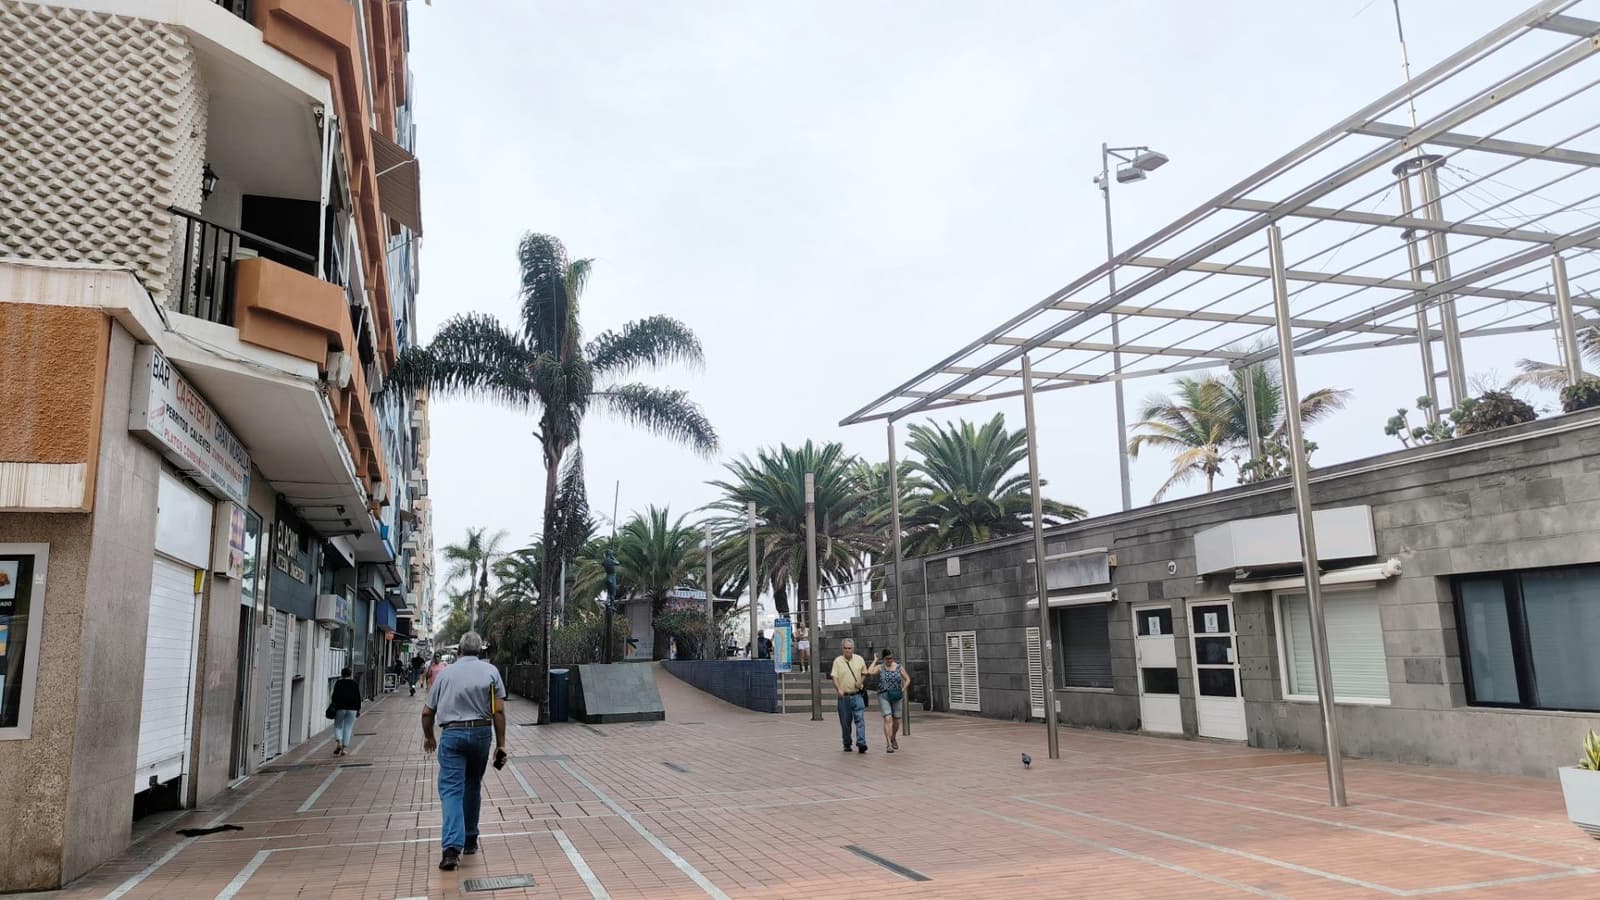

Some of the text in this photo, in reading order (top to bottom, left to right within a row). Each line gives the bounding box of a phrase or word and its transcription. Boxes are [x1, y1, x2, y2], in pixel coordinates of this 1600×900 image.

[153, 354, 170, 389] BAR
[166, 403, 188, 433] PERRITOS
[190, 427, 210, 454] CALIENTES
